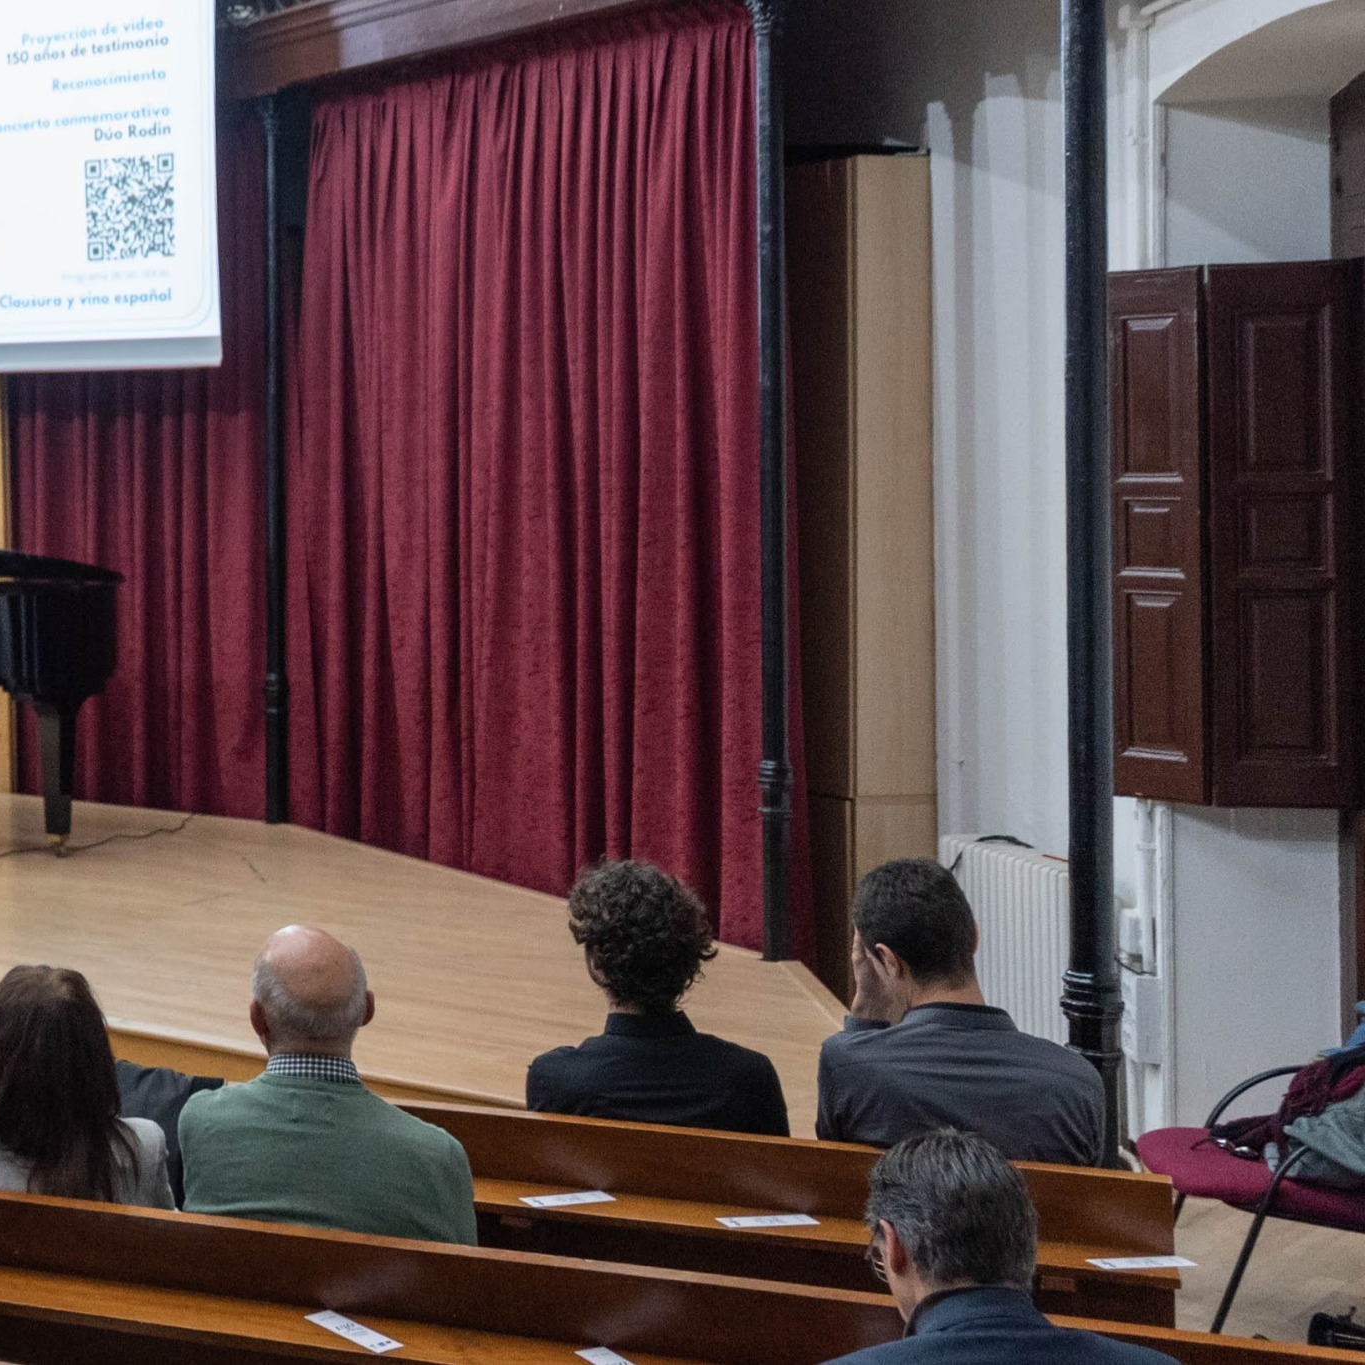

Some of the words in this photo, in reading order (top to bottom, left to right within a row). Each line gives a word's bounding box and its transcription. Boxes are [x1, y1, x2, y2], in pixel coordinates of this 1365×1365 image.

[101, 22, 118, 36] de
[6, 50, 29, 65] 150
[33, 46, 66, 63] años
[70, 43, 87, 58] de
[91, 33, 170, 55] testimonio
[51, 68, 167, 92] Reconocimiento
[55, 104, 171, 128] conmemorativo
[0, 293, 63, 309] Clausura
[67, 296, 75, 311] y
[80, 291, 110, 306] vino
[114, 286, 172, 307] español
